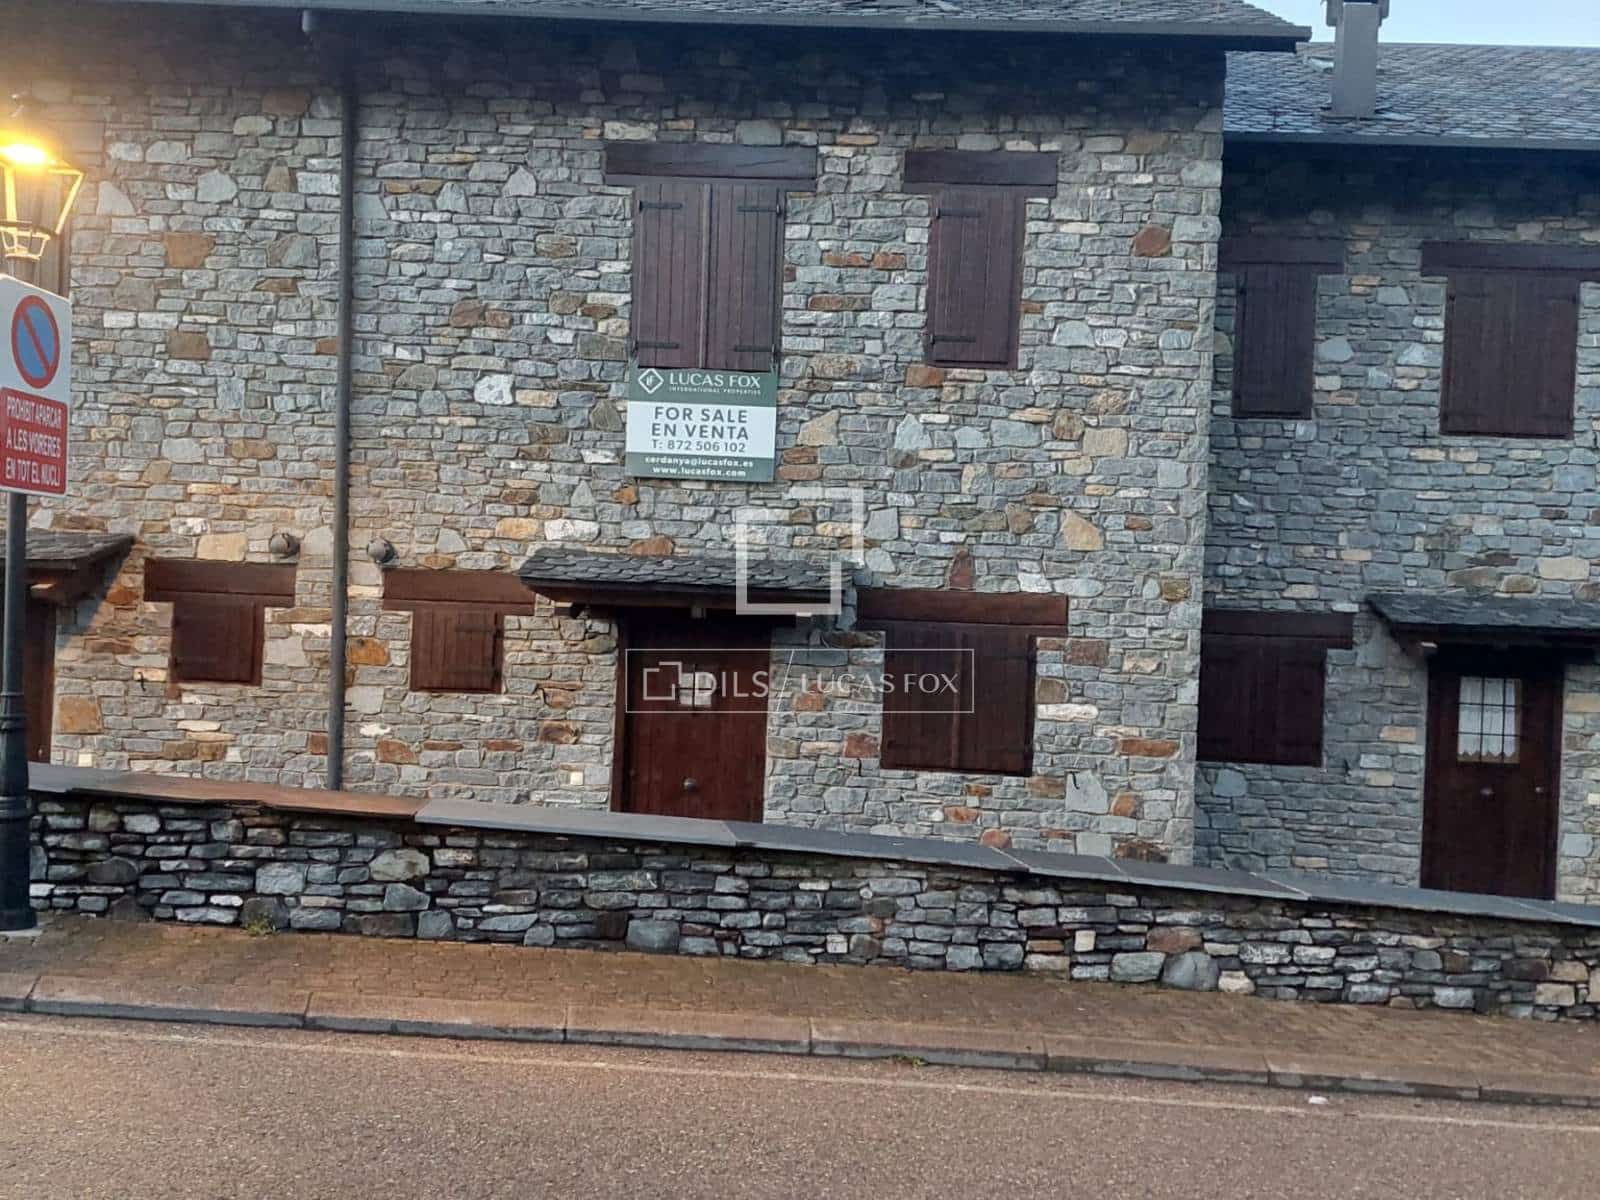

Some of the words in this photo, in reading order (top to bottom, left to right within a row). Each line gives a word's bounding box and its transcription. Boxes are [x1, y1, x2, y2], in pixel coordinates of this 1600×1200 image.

[669, 373, 724, 387] LUCAS
[729, 375, 761, 388] FOX
[654, 406, 693, 421] FOR
[701, 408, 748, 423] SALE
[6, 427, 13, 449] A
[14, 428, 28, 452] LES
[651, 423, 676, 437] EN
[685, 424, 749, 440] VENTA
[652, 439, 663, 449] T:
[667, 440, 692, 451] 872
[696, 441, 720, 452] 506
[724, 442, 746, 453] 102
[645, 455, 753, 467] cerdanya@lucasfox.es
[6, 456, 16, 479] EN
[17, 459, 31, 482] TOT
[31, 460, 40, 484] EL
[653, 466, 746, 477] www.lucasfox.com
